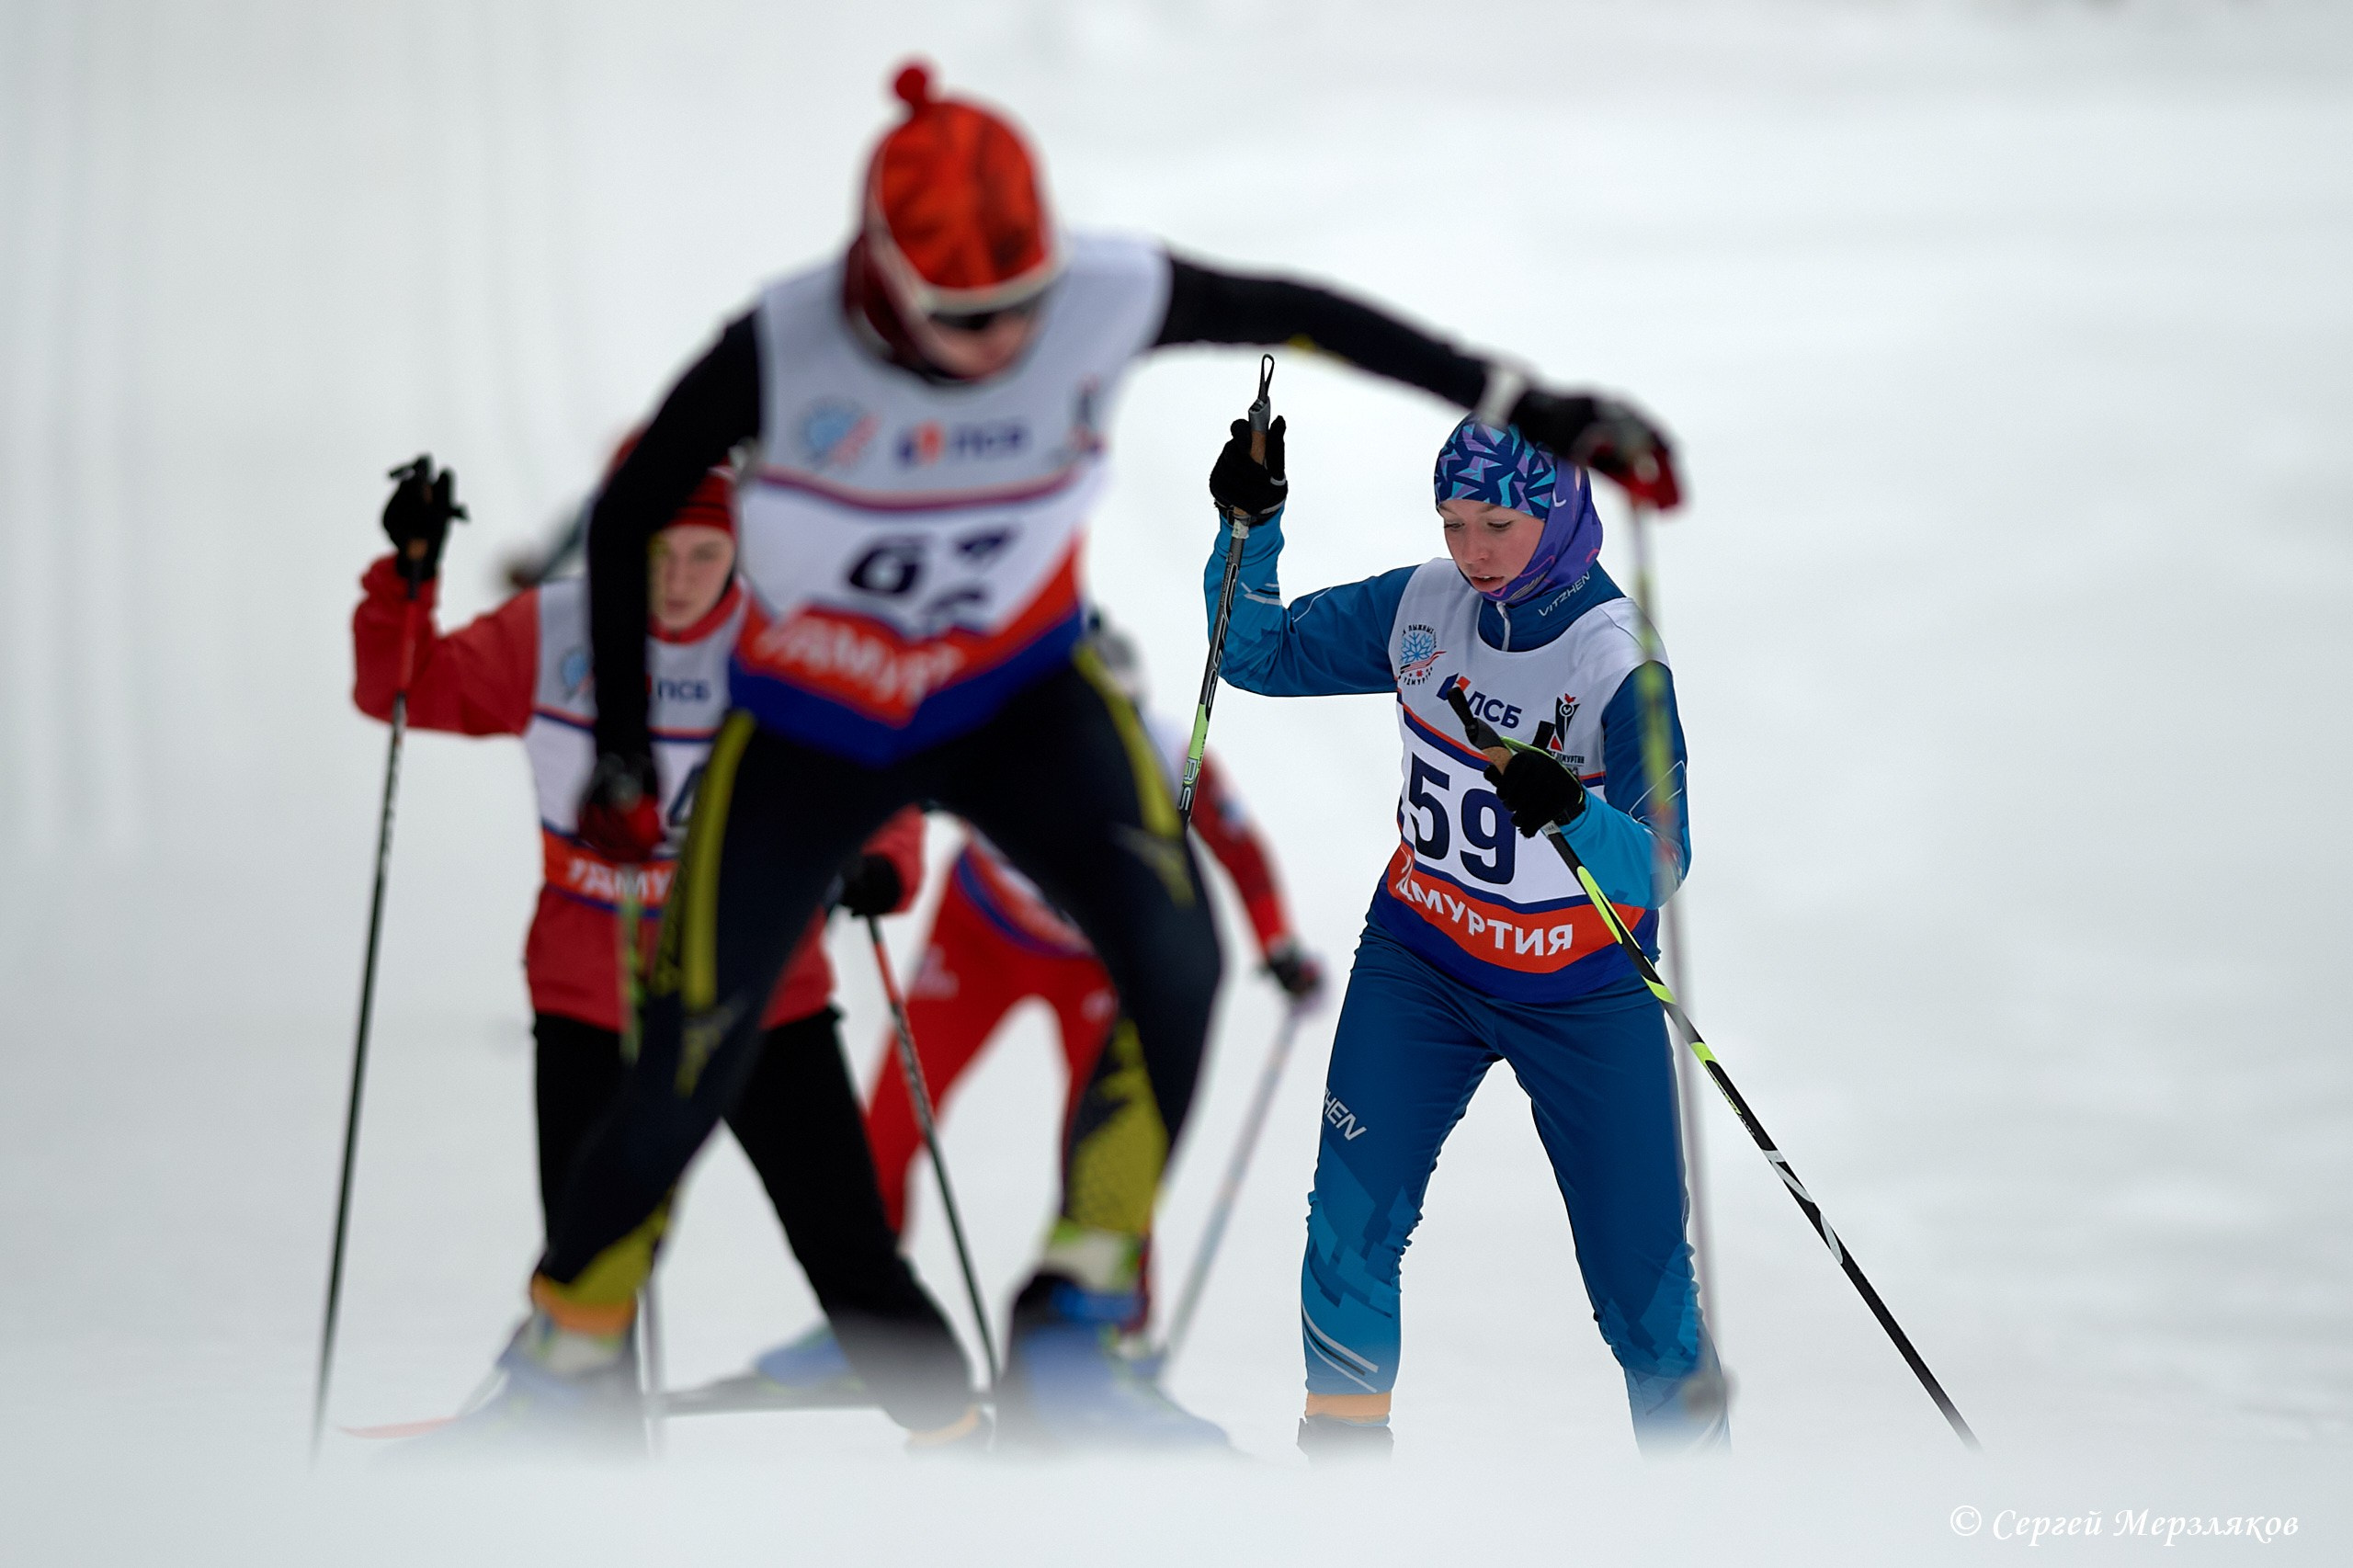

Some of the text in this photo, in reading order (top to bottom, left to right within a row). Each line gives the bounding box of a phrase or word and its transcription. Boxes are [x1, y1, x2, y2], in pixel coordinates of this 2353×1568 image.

[1538, 572, 1591, 617] VITZHEN
[1408, 751, 1516, 885] 59
[1324, 1087, 1367, 1141] HEN
